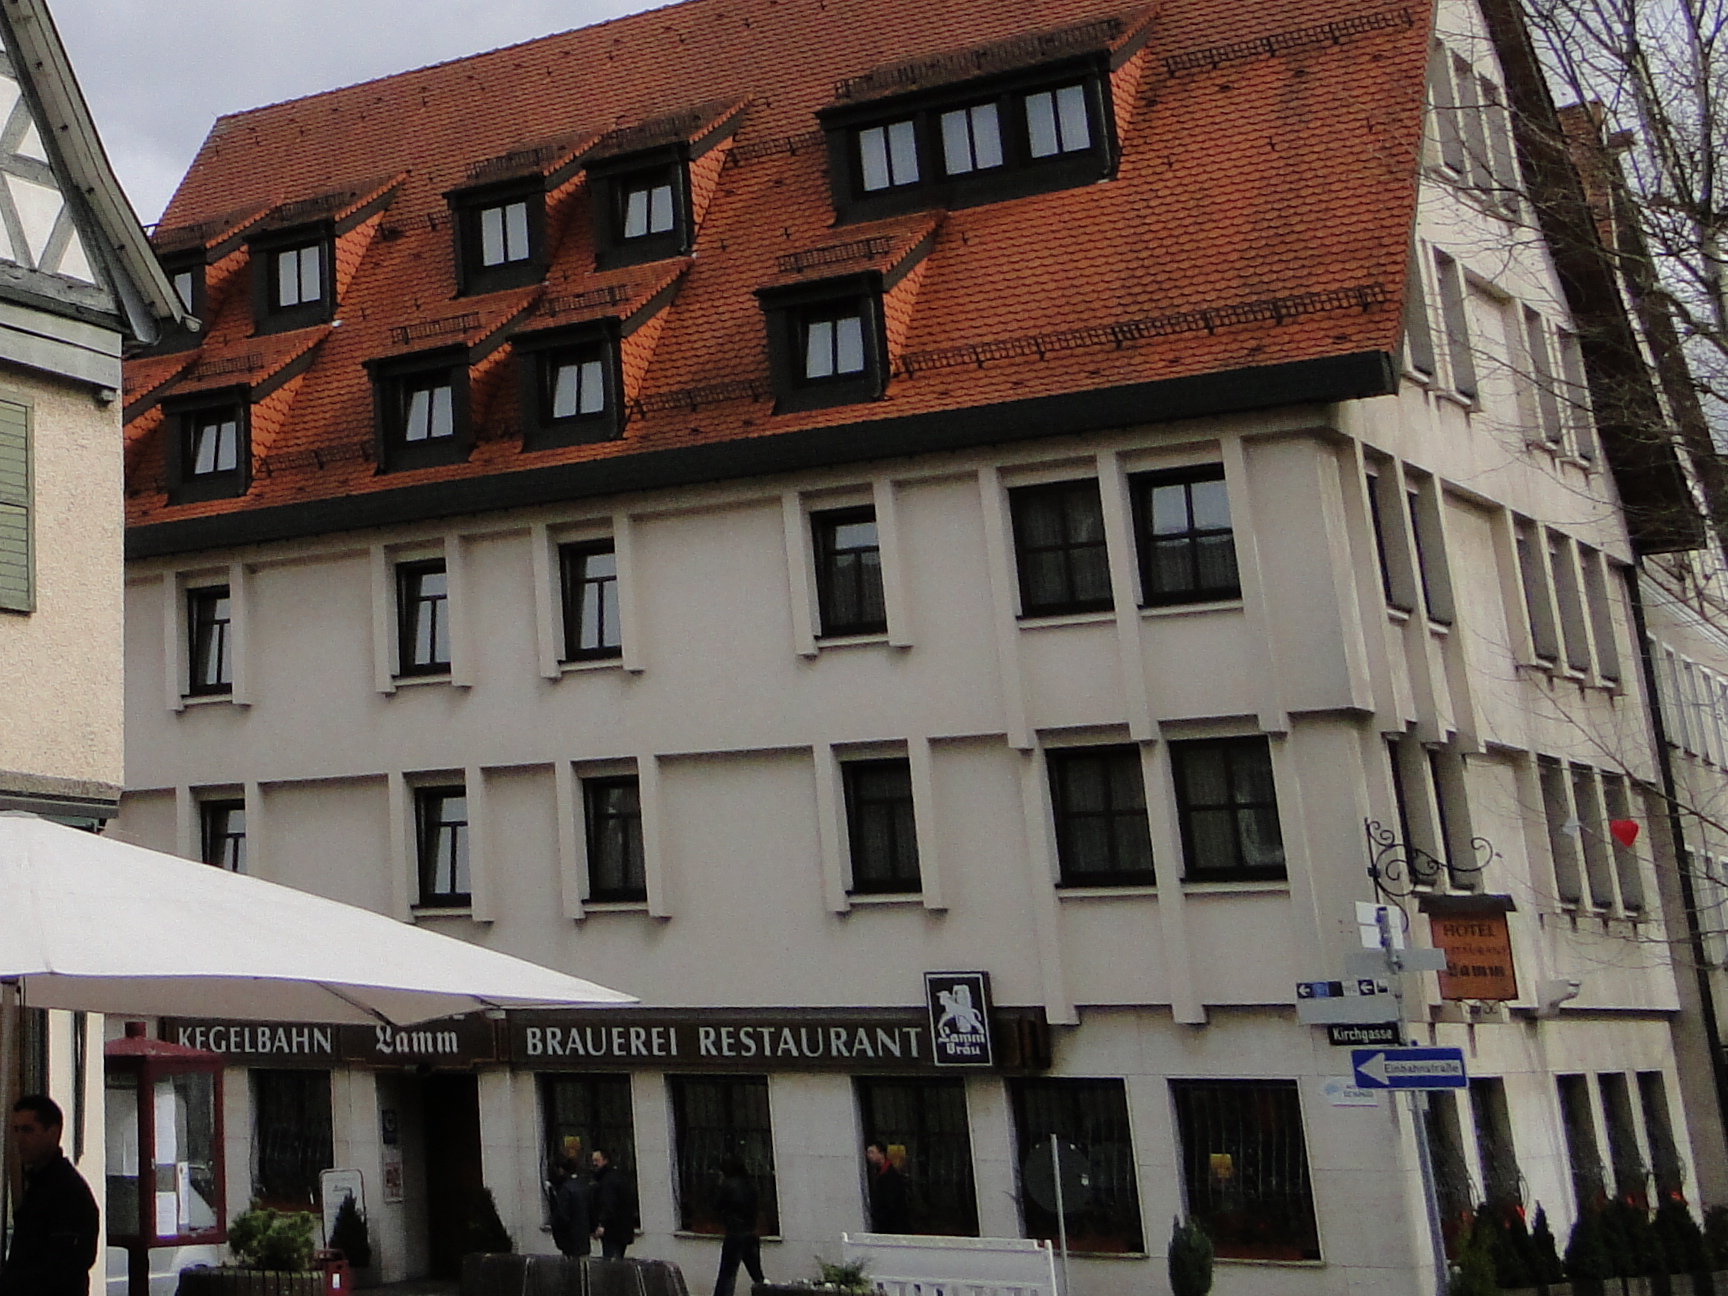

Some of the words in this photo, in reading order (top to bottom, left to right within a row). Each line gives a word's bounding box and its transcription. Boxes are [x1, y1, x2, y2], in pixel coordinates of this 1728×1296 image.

[1443, 923, 1496, 937] HOTEL
[178, 1026, 332, 1054] KEGELBAHN
[376, 1024, 459, 1054] Lamm
[526, 1027, 678, 1056] BRAUEREI
[699, 1026, 922, 1058] RESTAURANT
[937, 1026, 985, 1043] Lamm
[1333, 1027, 1392, 1042] Kirchgasse
[1384, 1061, 1459, 1075] Einbahnstraße
